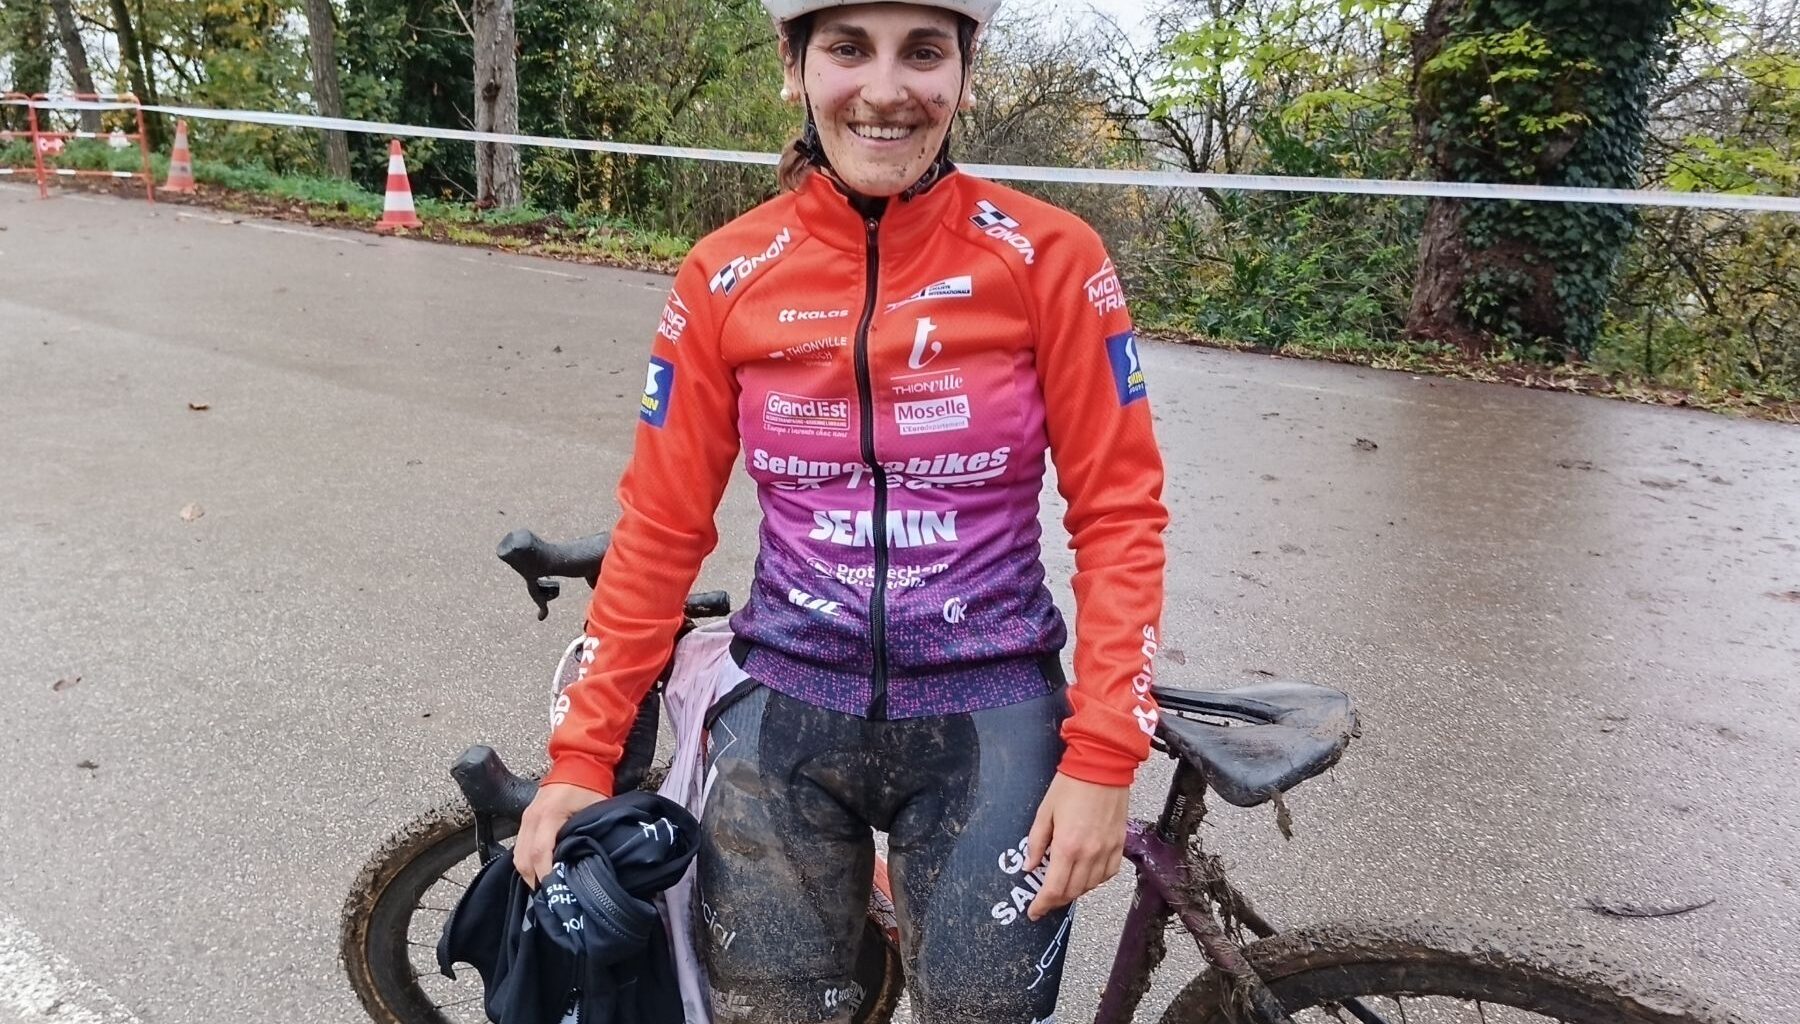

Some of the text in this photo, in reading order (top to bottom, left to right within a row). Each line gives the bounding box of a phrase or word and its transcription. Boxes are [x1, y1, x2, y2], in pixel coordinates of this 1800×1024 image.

[785, 336, 848, 358] THIONVILLE
[768, 394, 847, 418] Grand Est
[898, 399, 967, 421] Moselle
[808, 510, 959, 548] SEMIN
